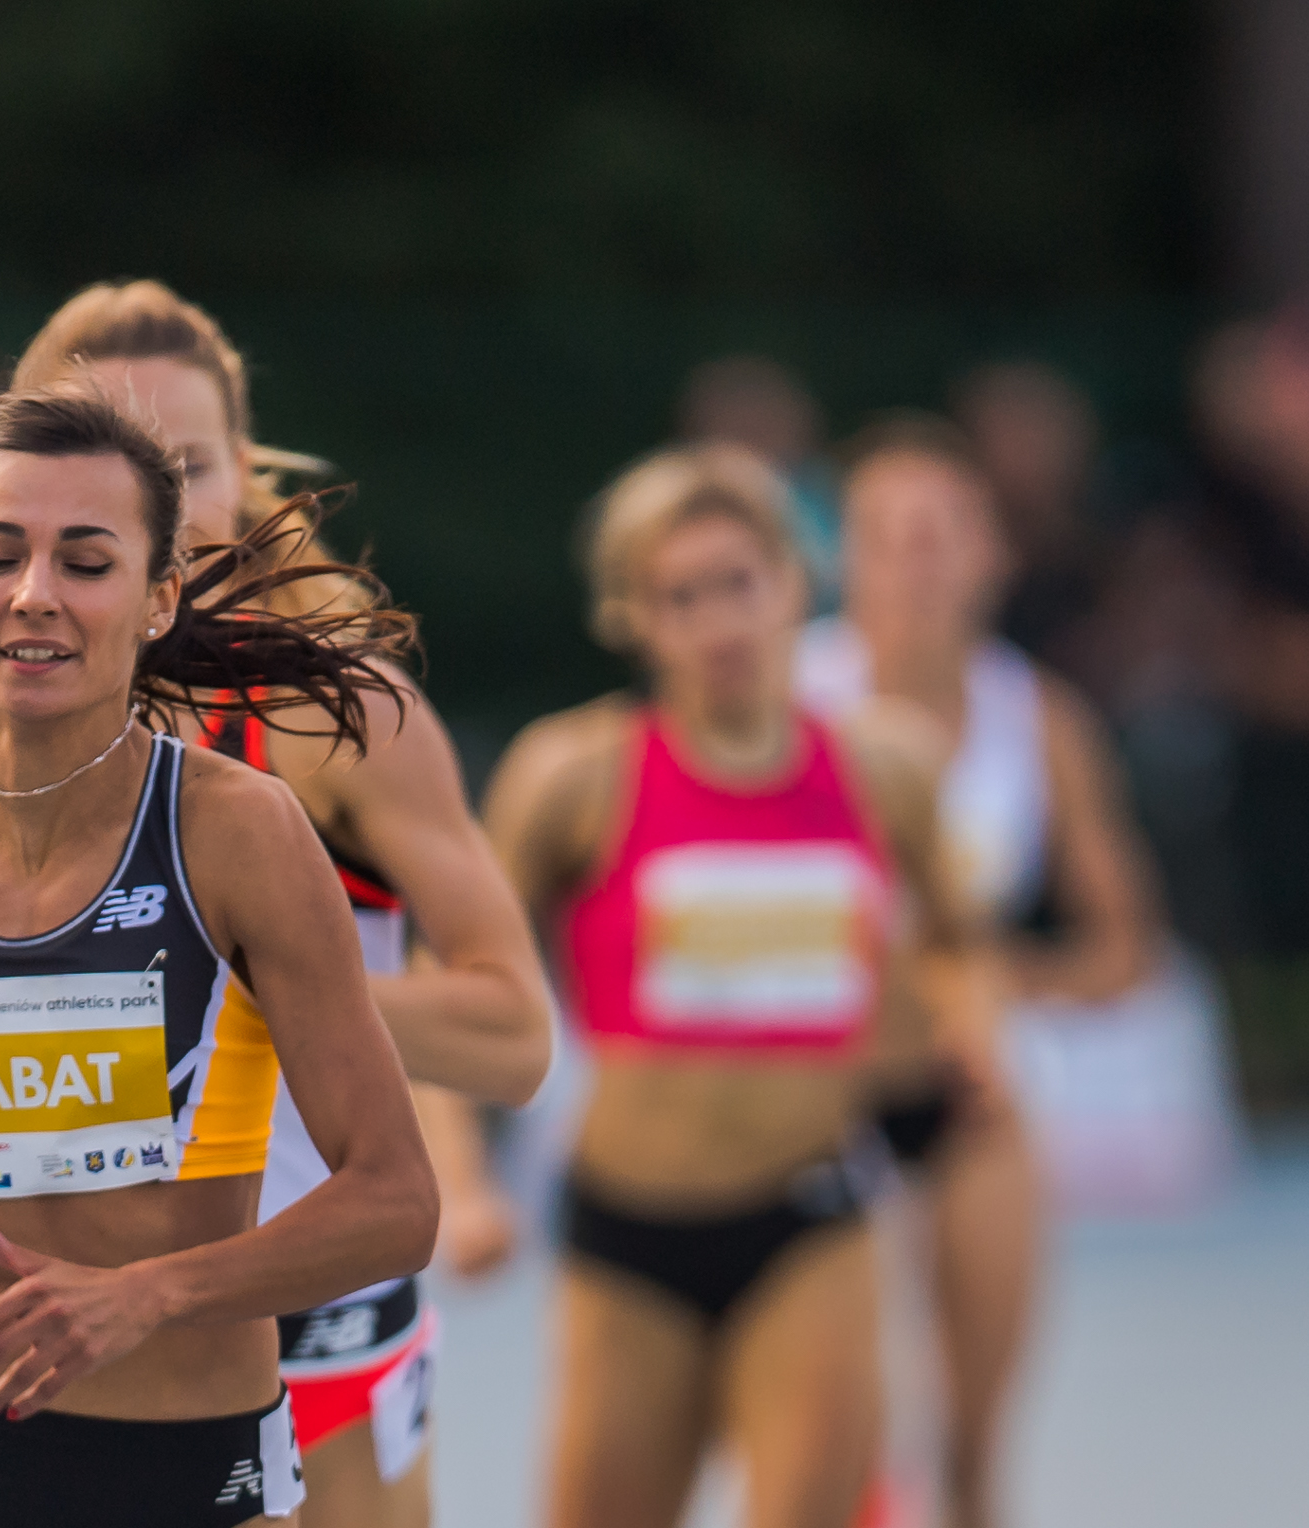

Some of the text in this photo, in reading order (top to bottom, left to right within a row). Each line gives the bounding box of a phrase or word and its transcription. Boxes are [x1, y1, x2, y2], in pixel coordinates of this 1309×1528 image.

[92, 884, 168, 933] NB
[46, 994, 114, 1011] athletics
[120, 993, 159, 1011] park
